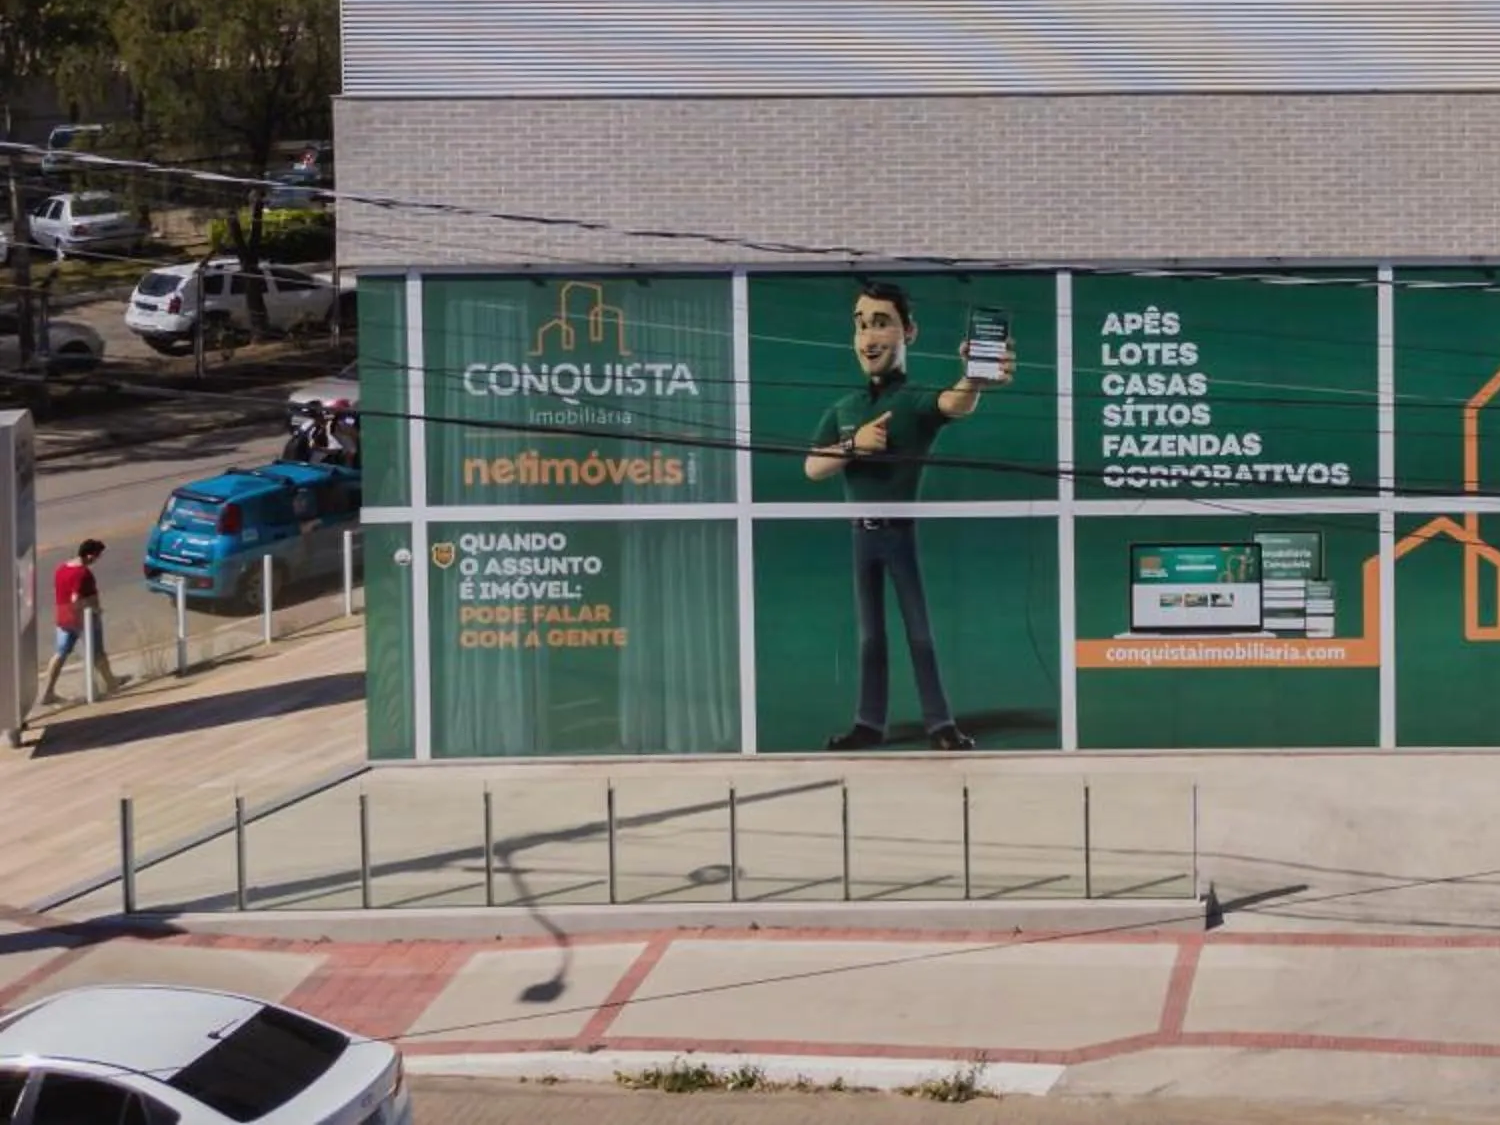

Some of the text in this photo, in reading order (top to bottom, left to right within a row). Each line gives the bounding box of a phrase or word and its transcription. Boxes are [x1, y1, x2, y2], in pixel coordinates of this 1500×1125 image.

[1101, 305, 1181, 336] APÊS
[1101, 342, 1199, 366] LOTES
[463, 362, 699, 405] CONQUISTA
[1101, 373, 1208, 396] CASAS
[1102, 397, 1211, 427] SÍTIOS
[1103, 433, 1262, 457] FAZENDAS
[463, 449, 683, 486] netimóveis
[459, 532, 567, 556] QUANDO
[459, 555, 603, 575] O ASSUNTO
[459, 576, 582, 600] É IMÓVEL:
[460, 604, 612, 624] PODE FALAR
[460, 627, 628, 649] COM A GENTE
[1106, 642, 1346, 665] conquistaimobiliaria.com
